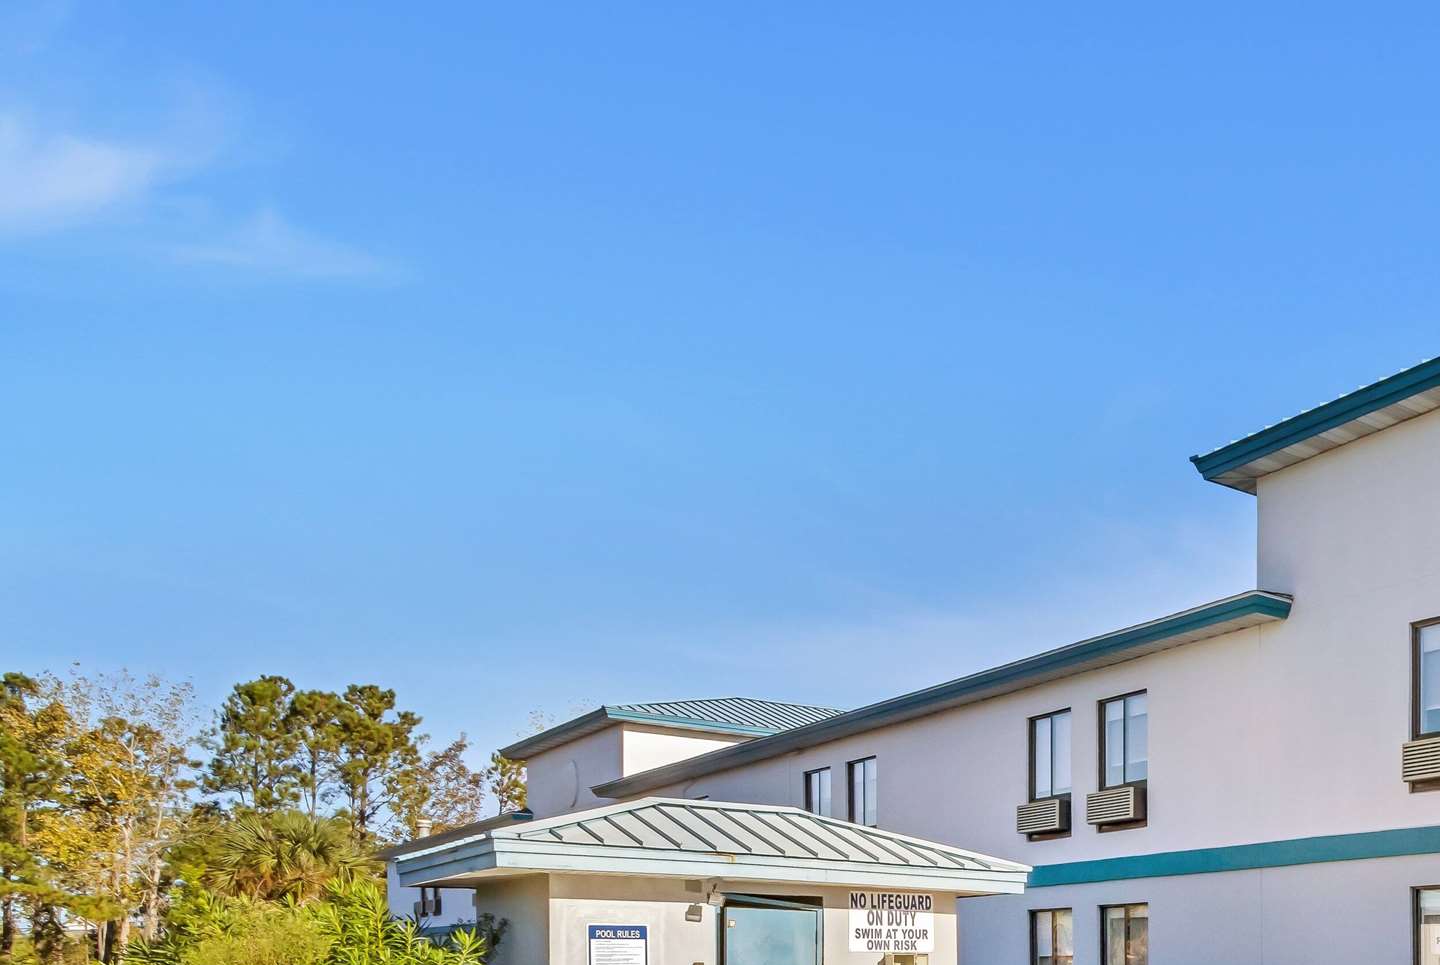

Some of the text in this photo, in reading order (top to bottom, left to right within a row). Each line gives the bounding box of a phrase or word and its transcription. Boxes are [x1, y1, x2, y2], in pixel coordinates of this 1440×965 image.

[850, 893, 932, 911] NO LIFEGUARD
[867, 910, 916, 927] ON DUTY
[595, 930, 640, 939] POOL RULES
[855, 928, 928, 940] SWIM AT YOUR
[867, 940, 917, 951] OWN RISK
